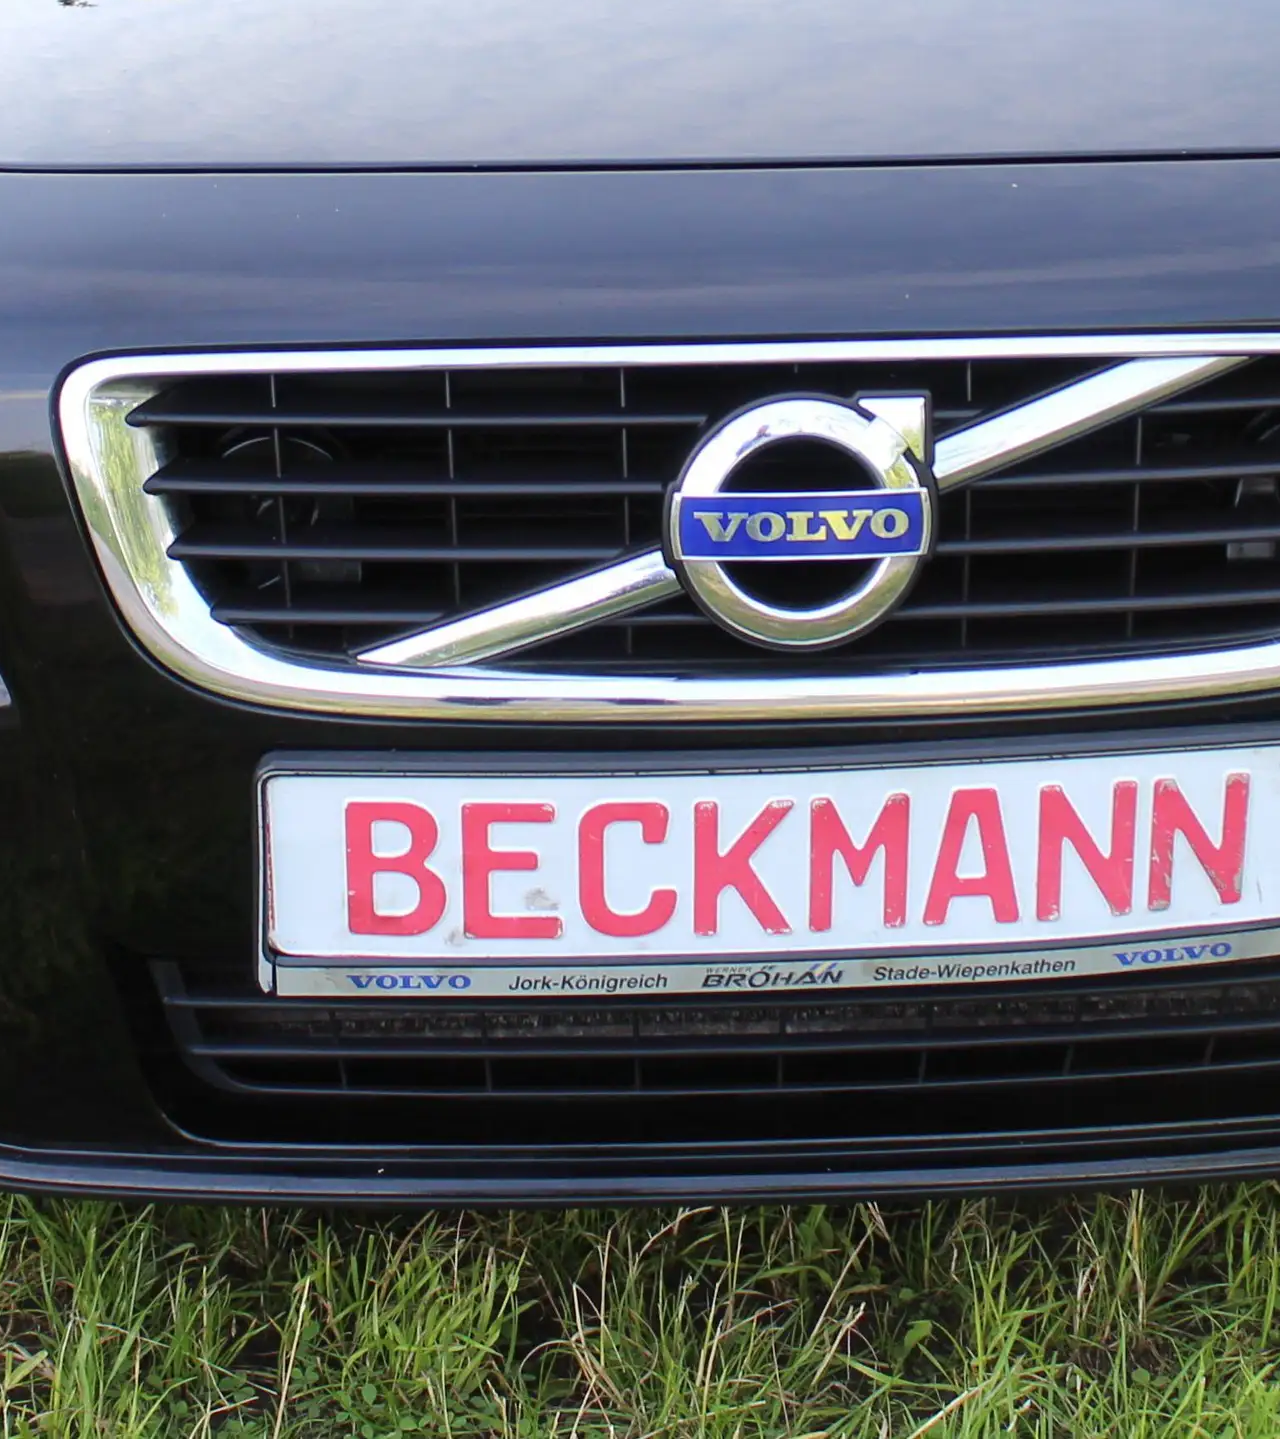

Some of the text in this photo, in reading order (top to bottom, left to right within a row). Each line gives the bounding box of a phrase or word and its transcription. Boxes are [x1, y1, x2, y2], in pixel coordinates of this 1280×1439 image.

[693, 508, 910, 542] VOLVO
[344, 778, 1249, 939] BECKMANN
[1111, 941, 1232, 966] VOLVO
[346, 974, 472, 989] VOLVO
[872, 958, 1076, 982] Stade-Wiepenkathen
[508, 973, 668, 993] Jork-Königreich
